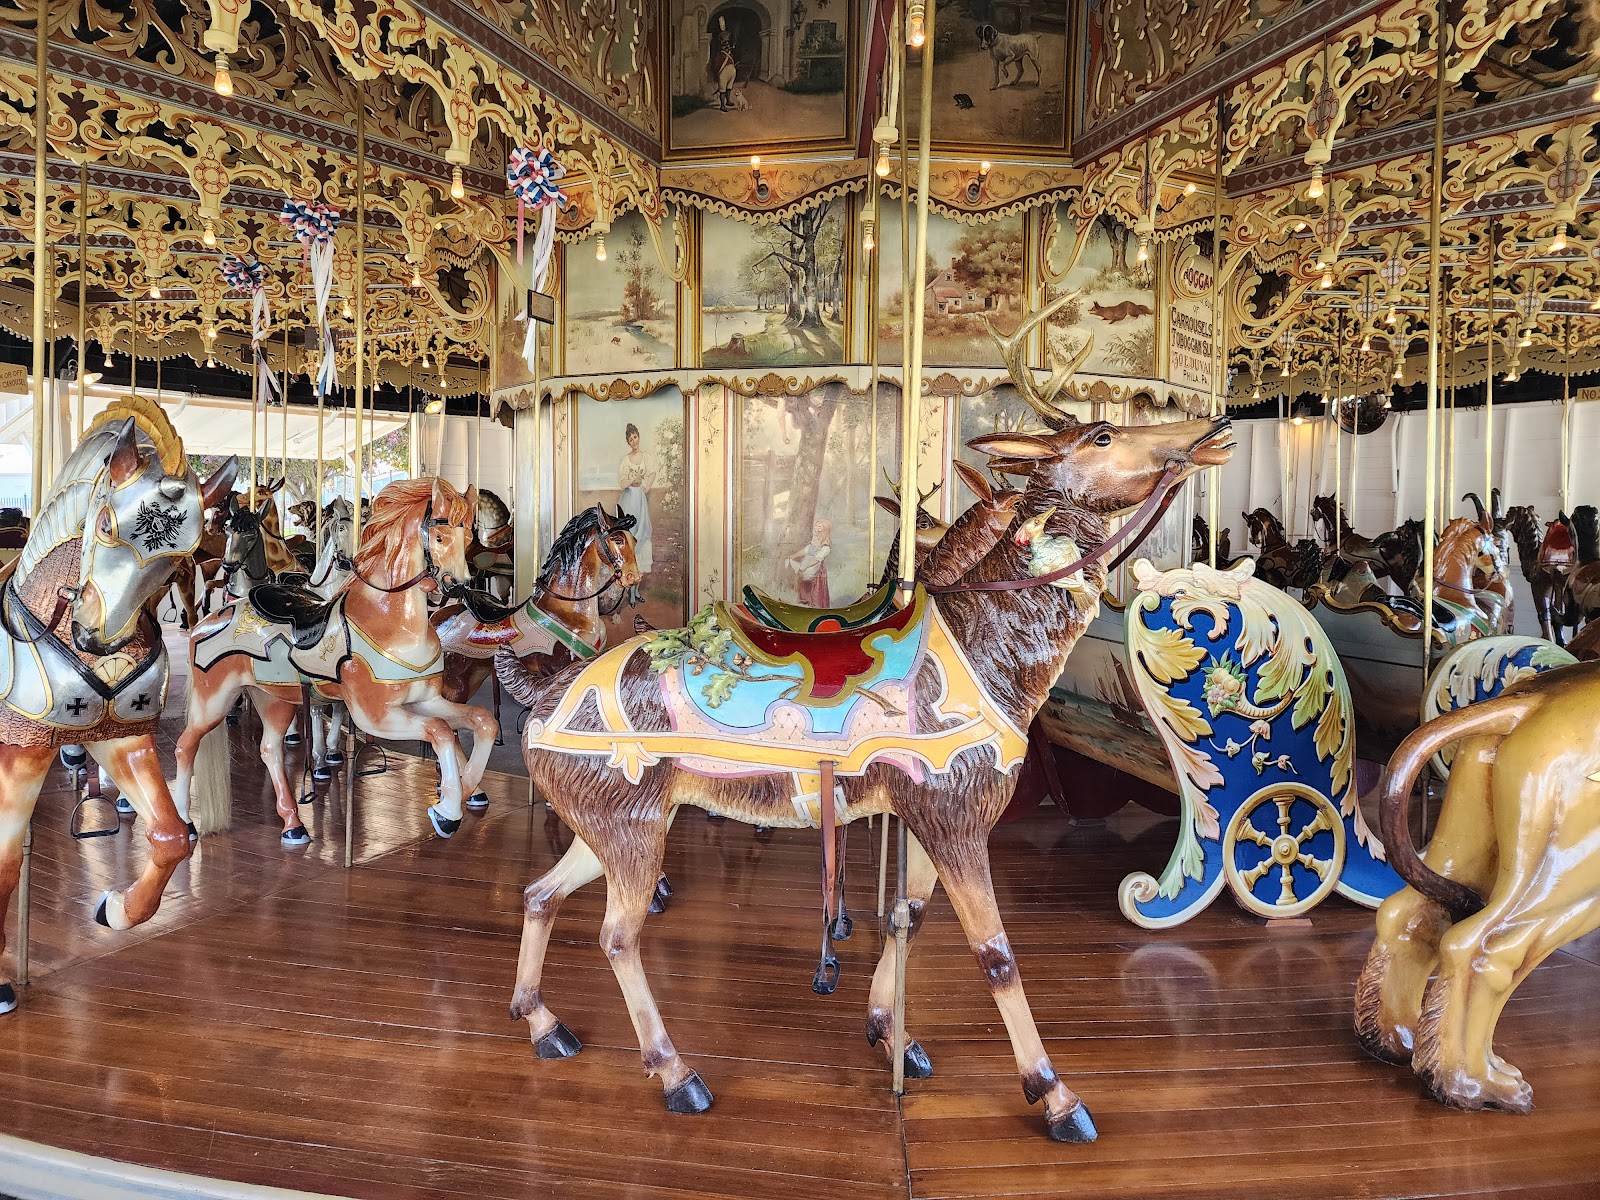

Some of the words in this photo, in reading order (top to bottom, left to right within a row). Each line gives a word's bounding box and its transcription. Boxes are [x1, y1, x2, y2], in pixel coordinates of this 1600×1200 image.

[1193, 304, 1200, 315] OF
[1172, 307, 1213, 339] CARROUSELS
[1172, 328, 1202, 355] TOBOGGAN
[1582, 389, 1596, 400] NO
